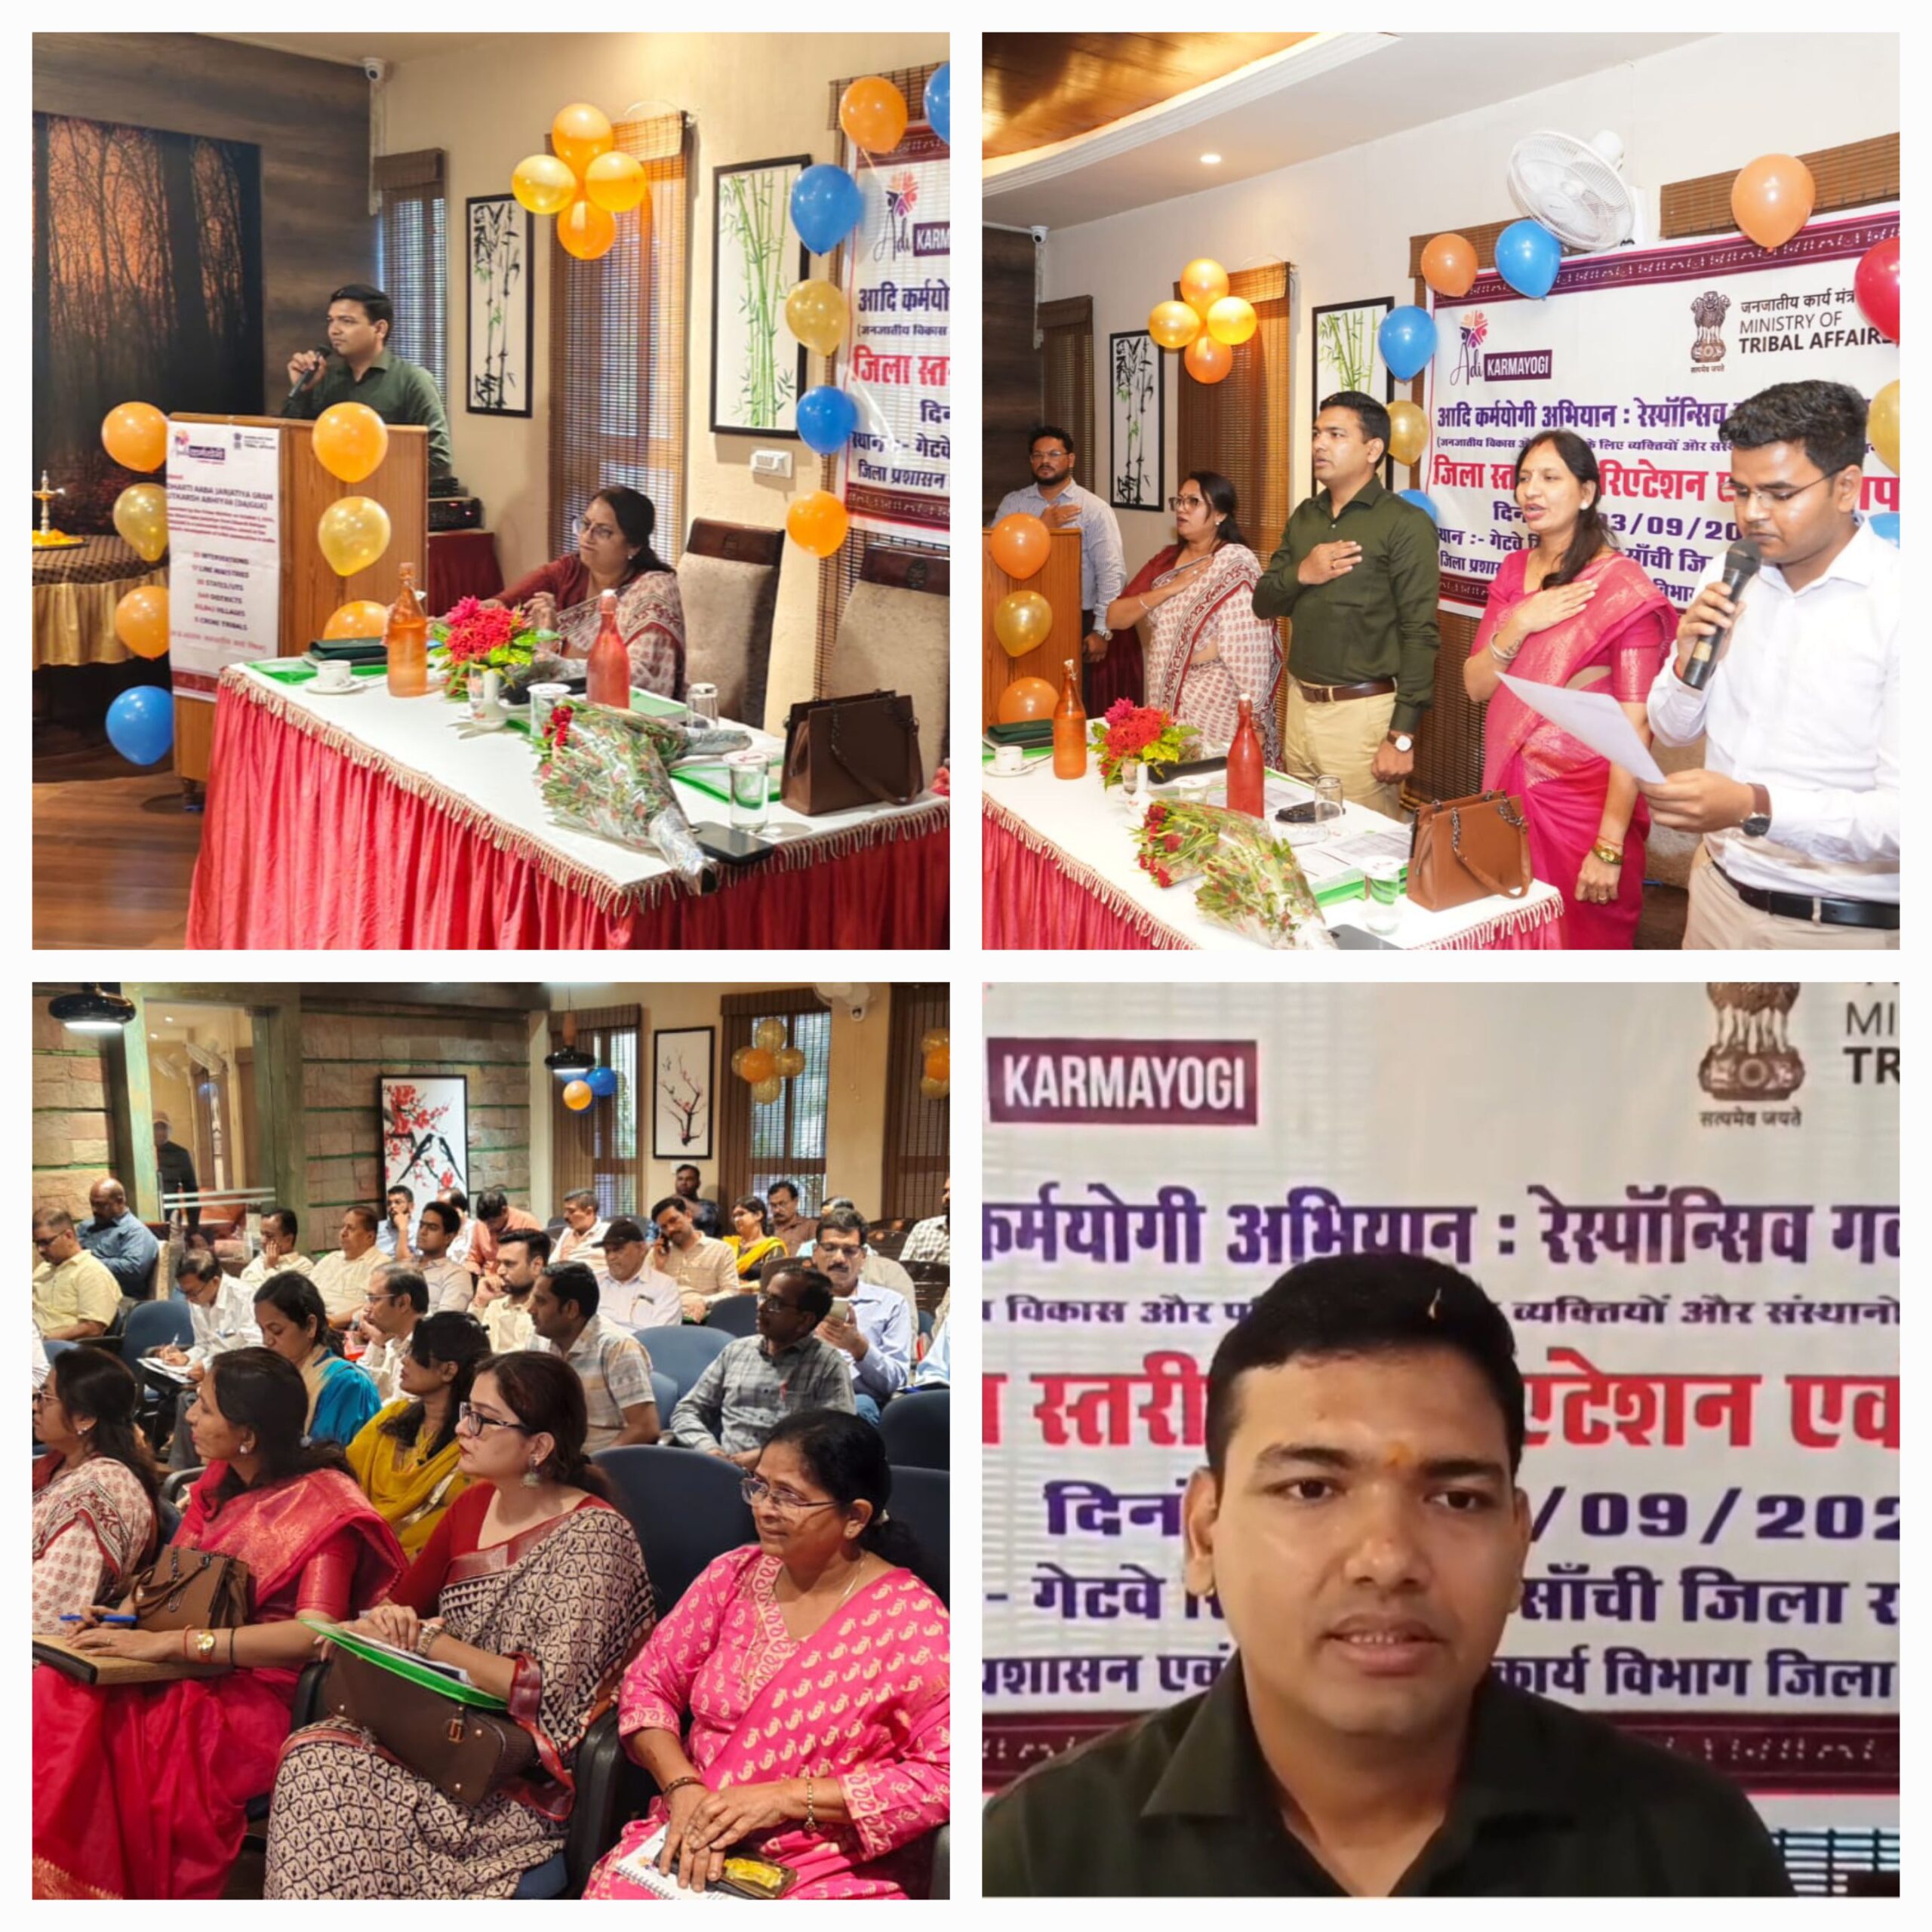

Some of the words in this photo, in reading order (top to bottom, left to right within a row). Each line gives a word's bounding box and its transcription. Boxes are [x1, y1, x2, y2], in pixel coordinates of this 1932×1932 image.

[858, 281, 898, 312] आदि
[1741, 293, 1799, 314] जनजातीय
[1804, 288, 1832, 308] कार्य
[1739, 313, 1816, 334] MINISTRY
[1819, 311, 1843, 328] OF
[1739, 334, 1804, 355] TRIBAL
[853, 344, 912, 385] जिला
[1450, 342, 1484, 386] Adi
[1487, 355, 1549, 377] KARMAYOGI
[1438, 401, 1472, 427] आदि
[1475, 399, 1536, 427] कर्मयोगी
[1542, 399, 1617, 427] अभियान
[1486, 437, 1515, 448] विकास
[1599, 438, 1624, 450] लिए
[1682, 439, 1707, 451] और
[858, 459, 888, 481] जिला
[891, 468, 946, 489] प्रशासन
[1433, 454, 1485, 488] जिला
[1599, 458, 1709, 501] रिएटेशन
[1490, 529, 1524, 551] गेटवे
[1440, 550, 1466, 571] जिला
[1004, 1054, 1245, 1109] KARMAYOGI
[1762, 1106, 1801, 1127] जयते
[1227, 1186, 1477, 1264] अभियान
[1527, 1185, 1814, 1264] रेस्पॉन्सिव
[1006, 1295, 1128, 1323] विकास
[1142, 1294, 1213, 1323] और
[1514, 1295, 1671, 1324] व्यक्तियों
[1681, 1295, 1754, 1324] और
[1030, 1351, 1208, 1446] स्तरी
[1031, 1563, 1167, 1619] गेटवे
[1521, 1563, 1662, 1623] साँची
[1680, 1566, 1850, 1624] जिला
[1604, 1647, 1752, 1697] विभाग
[1767, 1649, 1897, 1698] जिला
